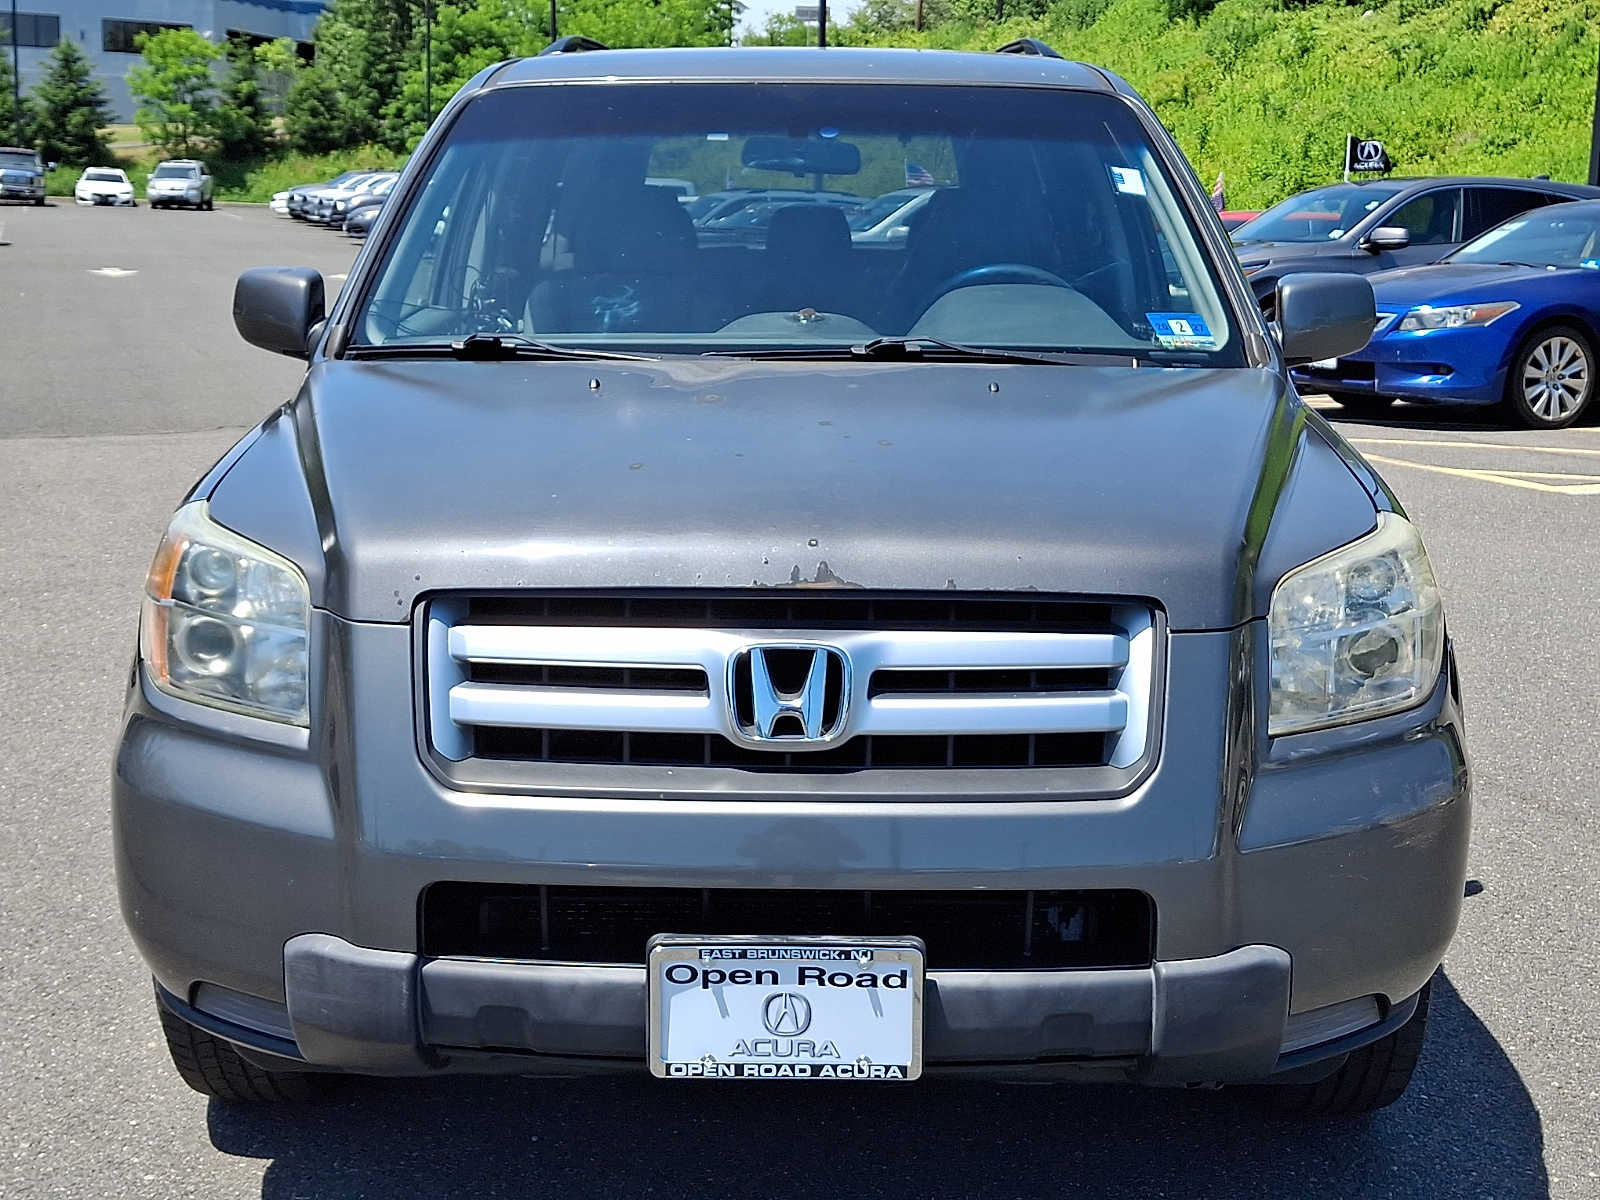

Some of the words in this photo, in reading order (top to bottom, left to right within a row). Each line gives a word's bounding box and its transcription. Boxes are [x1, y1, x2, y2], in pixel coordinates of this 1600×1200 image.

[1175, 321, 1187, 333] 2
[701, 949, 741, 960] EAST
[850, 950, 873, 961] NJ
[665, 964, 779, 990] Open
[797, 966, 908, 989] Road
[728, 1038, 841, 1058] ACURA
[669, 1063, 736, 1077] OPEN
[743, 1064, 812, 1077] ROAD
[819, 1064, 903, 1079] ACURA
